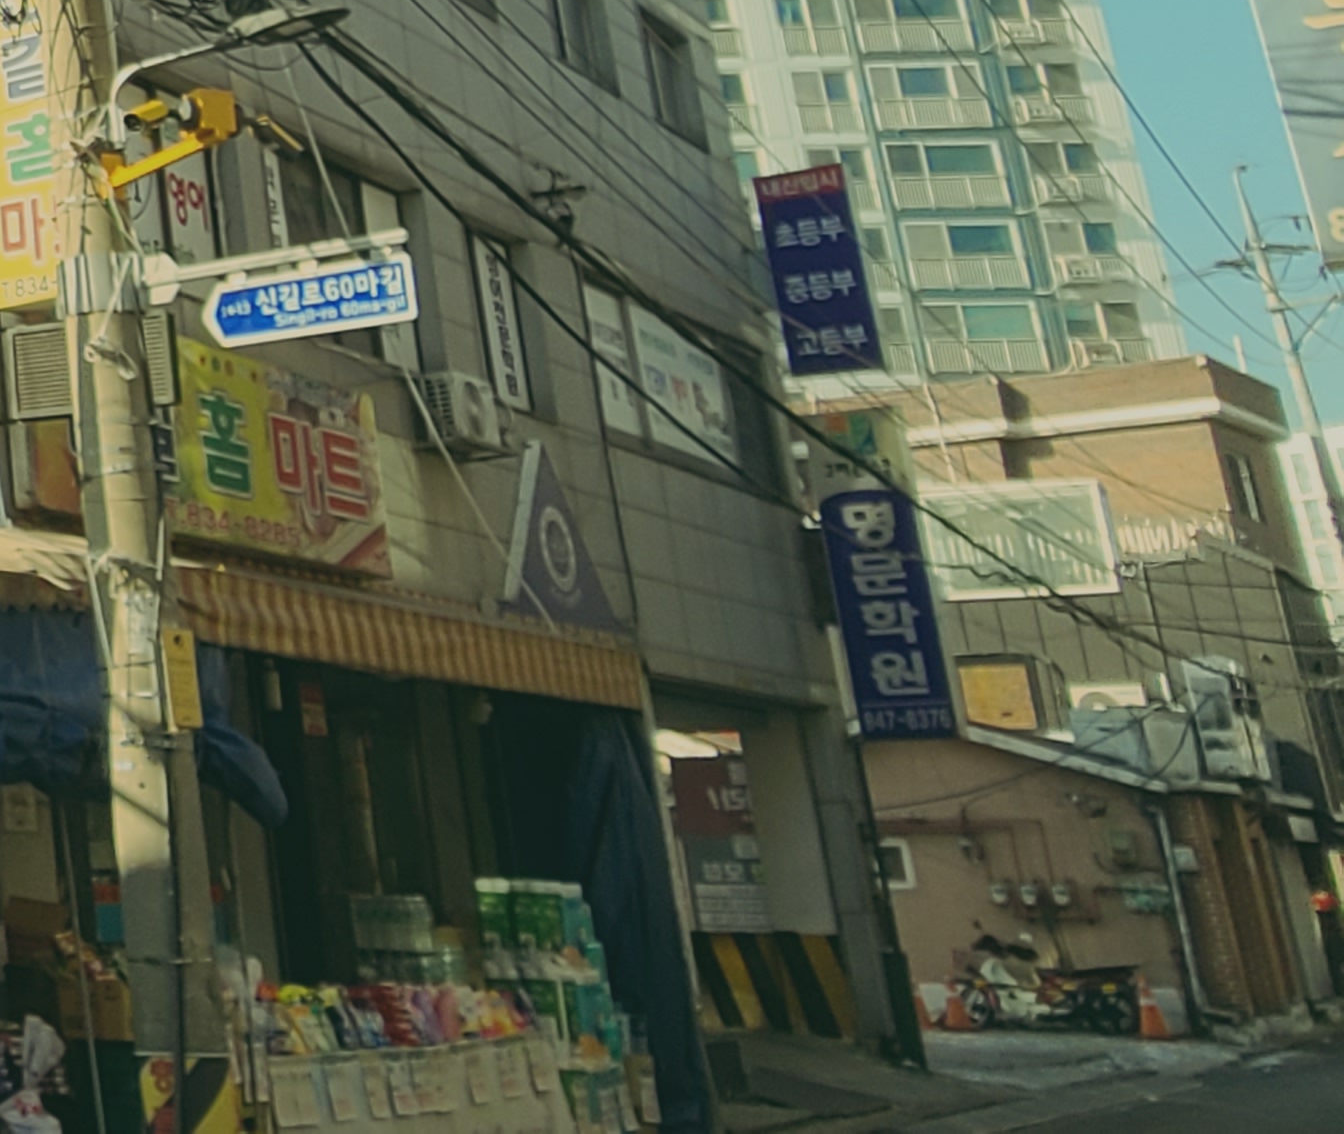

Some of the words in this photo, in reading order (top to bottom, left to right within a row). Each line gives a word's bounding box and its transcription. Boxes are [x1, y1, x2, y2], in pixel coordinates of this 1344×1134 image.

[167, 172, 211, 234] 영어
[774, 215, 846, 249] 초등부
[254, 266, 405, 317] 신길로60마길
[783, 268, 857, 304] 중등부
[273, 305, 339, 329] Singil-ro
[795, 323, 869, 356] 고등부
[197, 390, 254, 500] 홈
[268, 411, 372, 526] 마트
[840, 500, 931, 697] 명문학원
